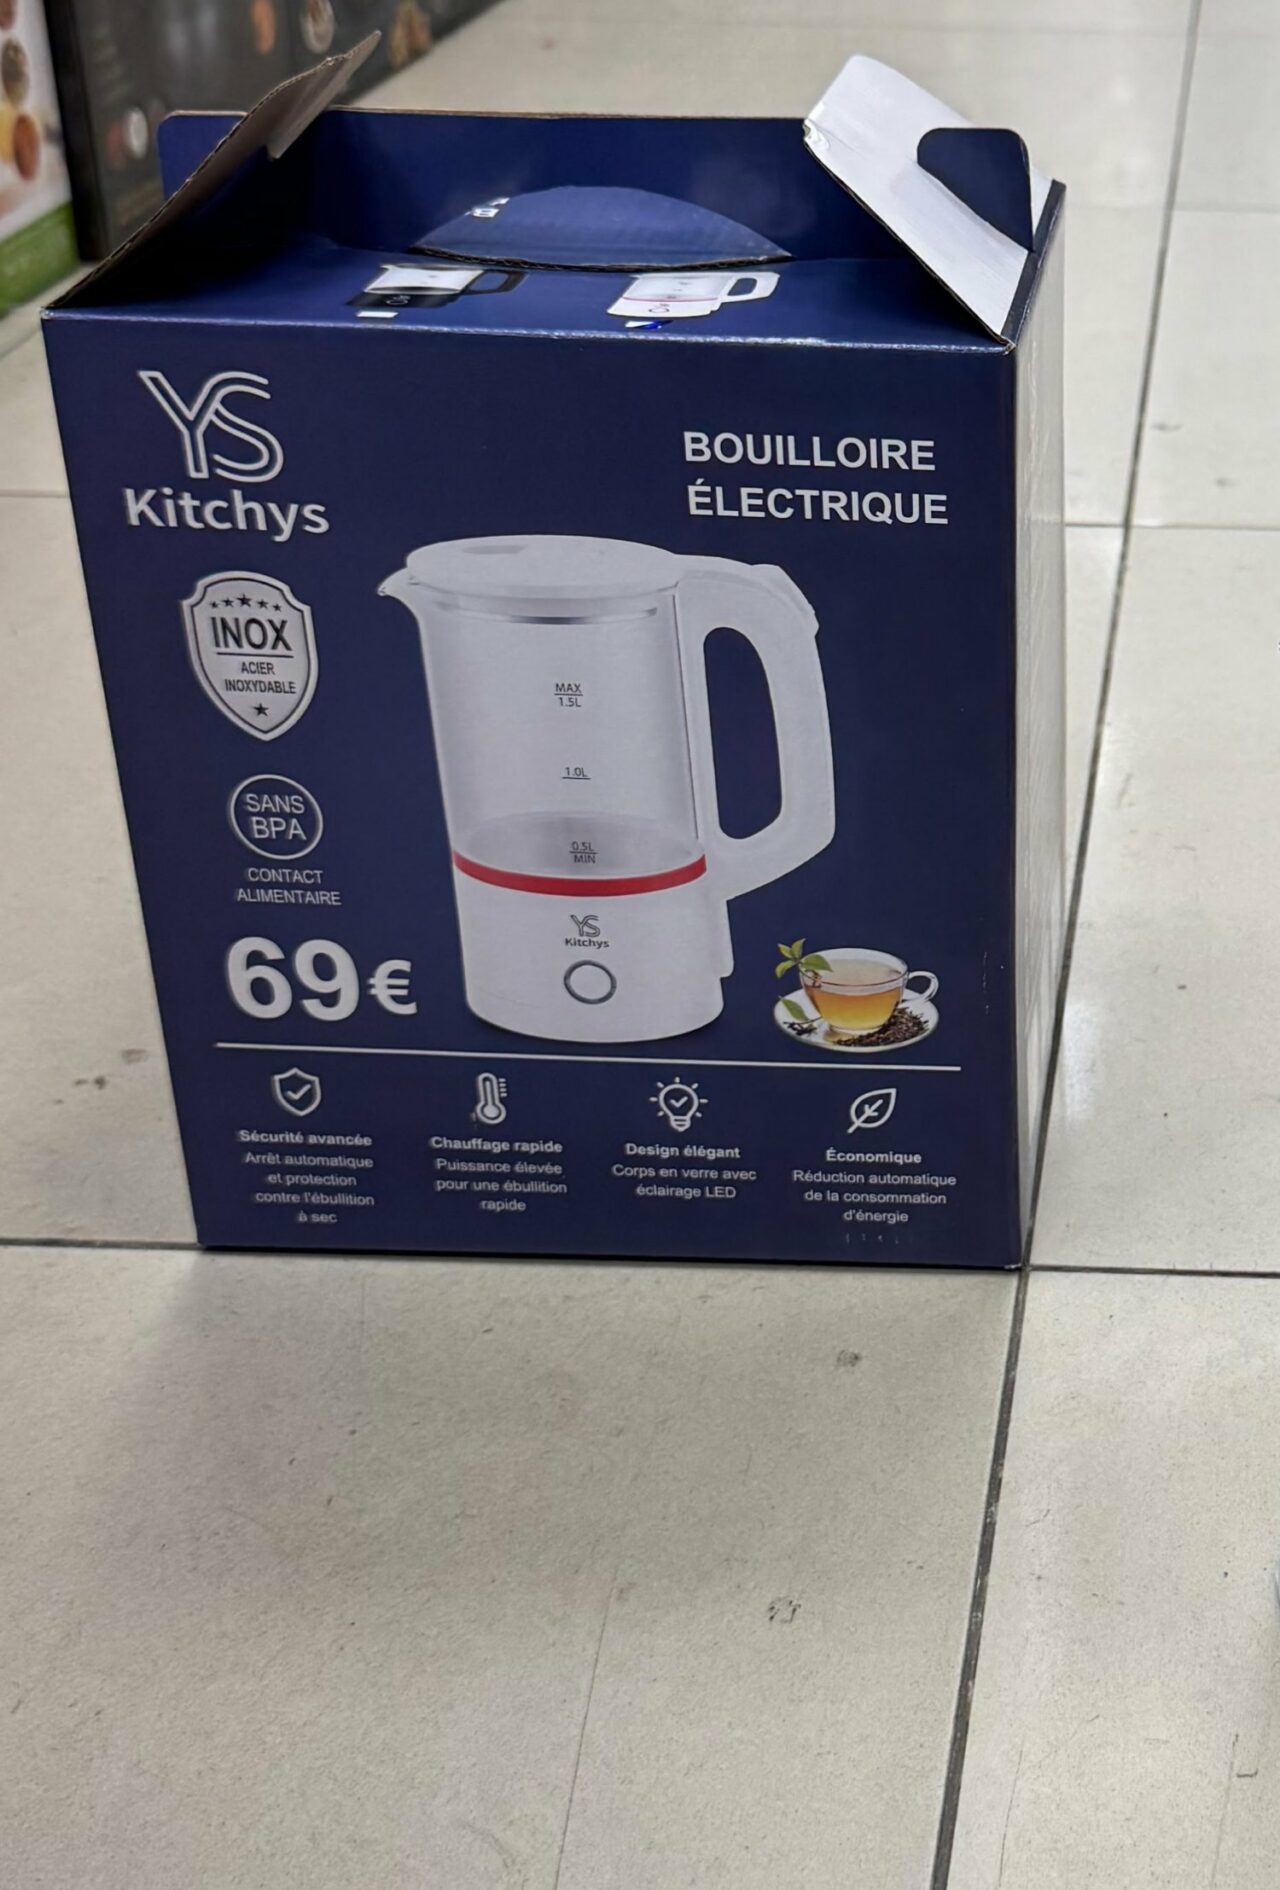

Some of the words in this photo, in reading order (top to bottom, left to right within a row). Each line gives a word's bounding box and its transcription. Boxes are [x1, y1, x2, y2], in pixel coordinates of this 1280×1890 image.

[137, 370, 284, 483] YS
[683, 431, 936, 471] BOUILLOIRE
[687, 478, 949, 525] ÉLECTRIQUE
[123, 487, 330, 542] Kitchys
[211, 616, 293, 651] INOX
[241, 661, 276, 675] ACIER
[224, 679, 296, 694] INOXYDABLE
[555, 682, 582, 694] MAX
[558, 696, 582, 708] 1.5L
[565, 766, 588, 777] 1.0L
[245, 793, 305, 814] SANS
[252, 817, 307, 840] BPA
[571, 840, 594, 851] 0.5L
[573, 853, 596, 864] MIN
[247, 867, 323, 884] CONTACT
[236, 888, 342, 905] ALIMENTAIRE
[569, 914, 601, 937] YS
[564, 937, 610, 949] Kitchys
[238, 1129, 304, 1144] Sécurité
[308, 1133, 373, 1147] avancée
[430, 1136, 510, 1153] Chauffage
[514, 1140, 563, 1154] rapide
[624, 1142, 679, 1159] Design
[684, 1144, 741, 1160] élégant
[825, 1146, 922, 1165] Économique
[245, 1151, 281, 1165] Arrêt
[285, 1153, 374, 1169] automatique
[435, 1157, 511, 1173] Puissance
[514, 1161, 563, 1174] élevée
[268, 1173, 282, 1184] et
[286, 1173, 357, 1187] protection
[612, 1163, 656, 1179] Corps
[659, 1167, 678, 1178] en
[682, 1168, 719, 1179] verre
[722, 1169, 757, 1180] avec
[793, 1169, 864, 1184] Réduction
[868, 1172, 957, 1188] automatique
[436, 1179, 469, 1192] pour
[473, 1180, 500, 1191] une
[503, 1179, 567, 1193] ébullition
[637, 1183, 701, 1199] éclairage
[705, 1186, 736, 1198] LED
[255, 1192, 300, 1203] contre
[303, 1191, 375, 1206] l'ébullition
[480, 1199, 527, 1212] rapide
[804, 1189, 823, 1201] de
[827, 1190, 839, 1202] la
[843, 1191, 947, 1205] consommation
[298, 1210, 307, 1223] à
[311, 1212, 338, 1223] sec
[843, 1209, 909, 1225] d'énergie
